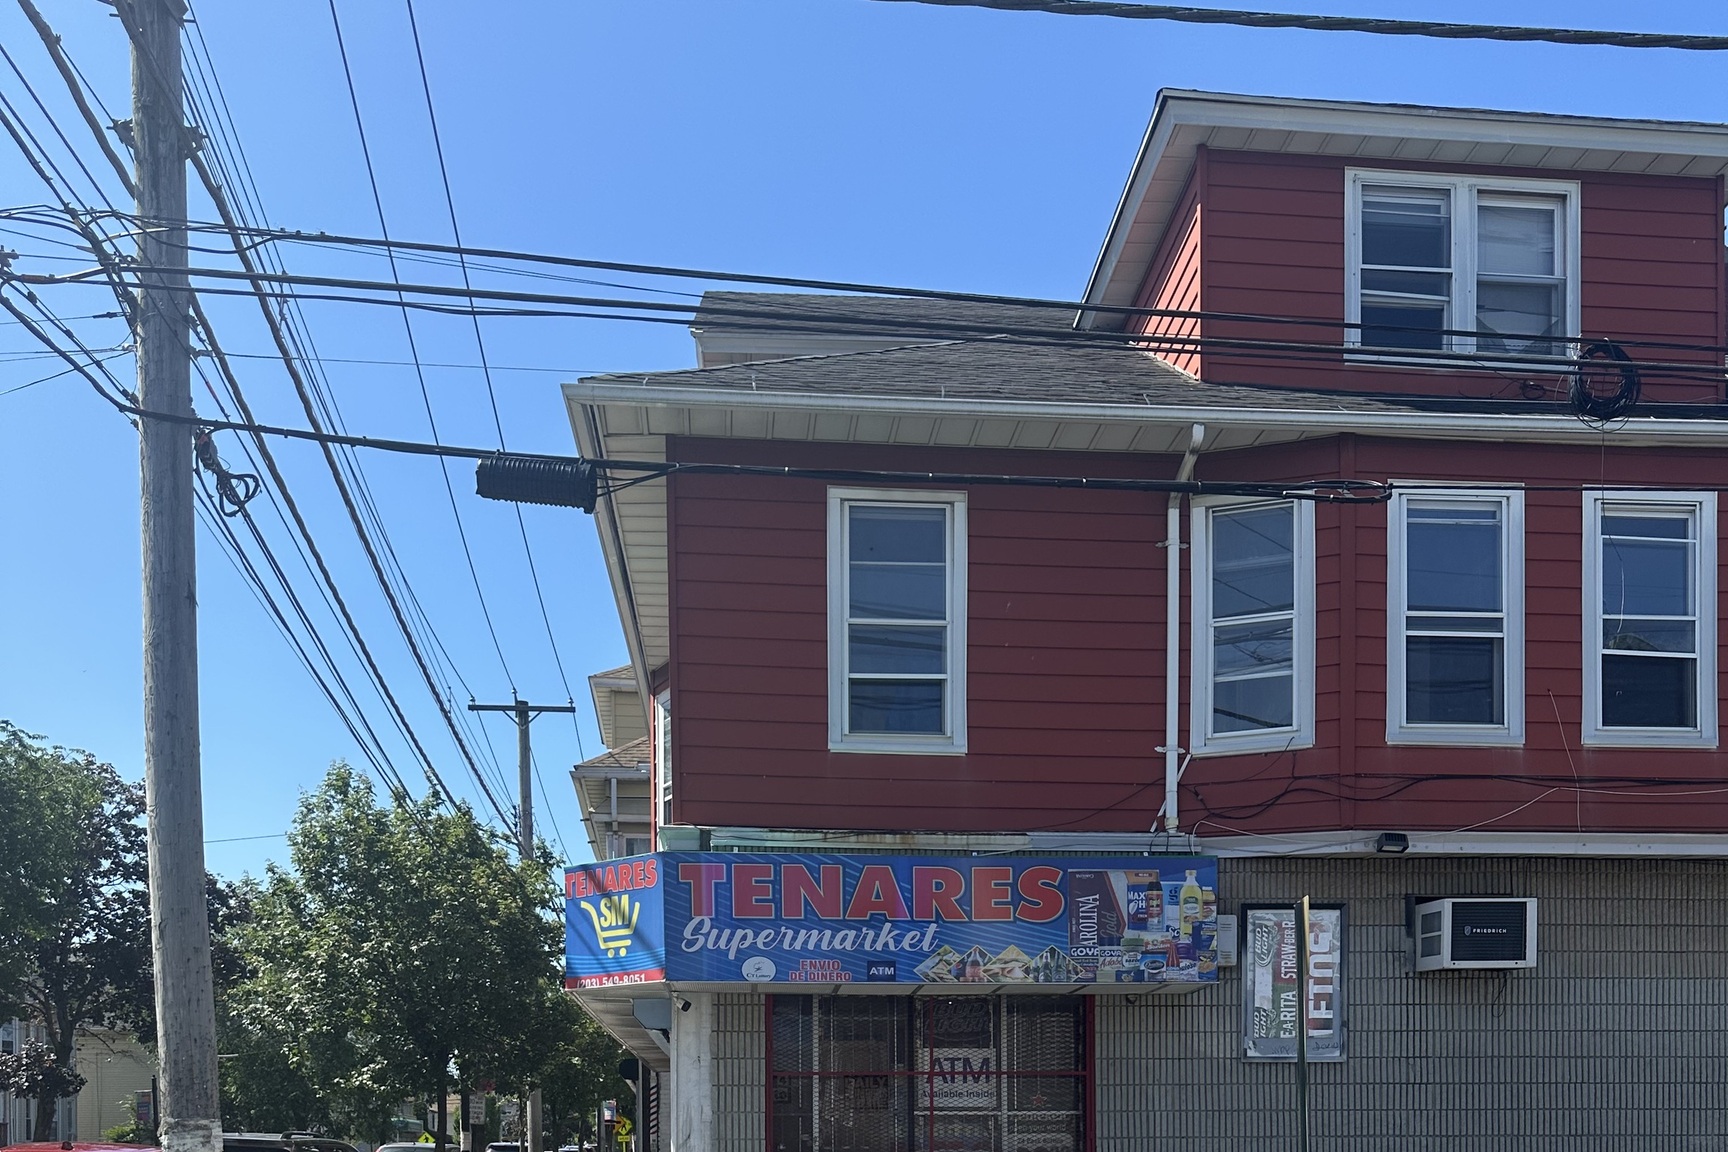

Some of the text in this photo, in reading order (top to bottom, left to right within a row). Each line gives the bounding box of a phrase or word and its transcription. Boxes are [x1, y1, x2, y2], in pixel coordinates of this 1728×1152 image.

[565, 859, 658, 900] TENARES
[678, 863, 1065, 923] TENARES
[1128, 891, 1147, 900] MAX
[600, 894, 629, 928] SM
[681, 915, 939, 960] Supermarket
[1261, 925, 1269, 960] LIGHT
[789, 970, 852, 981] DE DINERO
[800, 959, 841, 971] ENVIO
[869, 966, 895, 975] ATM
[925, 1057, 990, 1084] ATM
